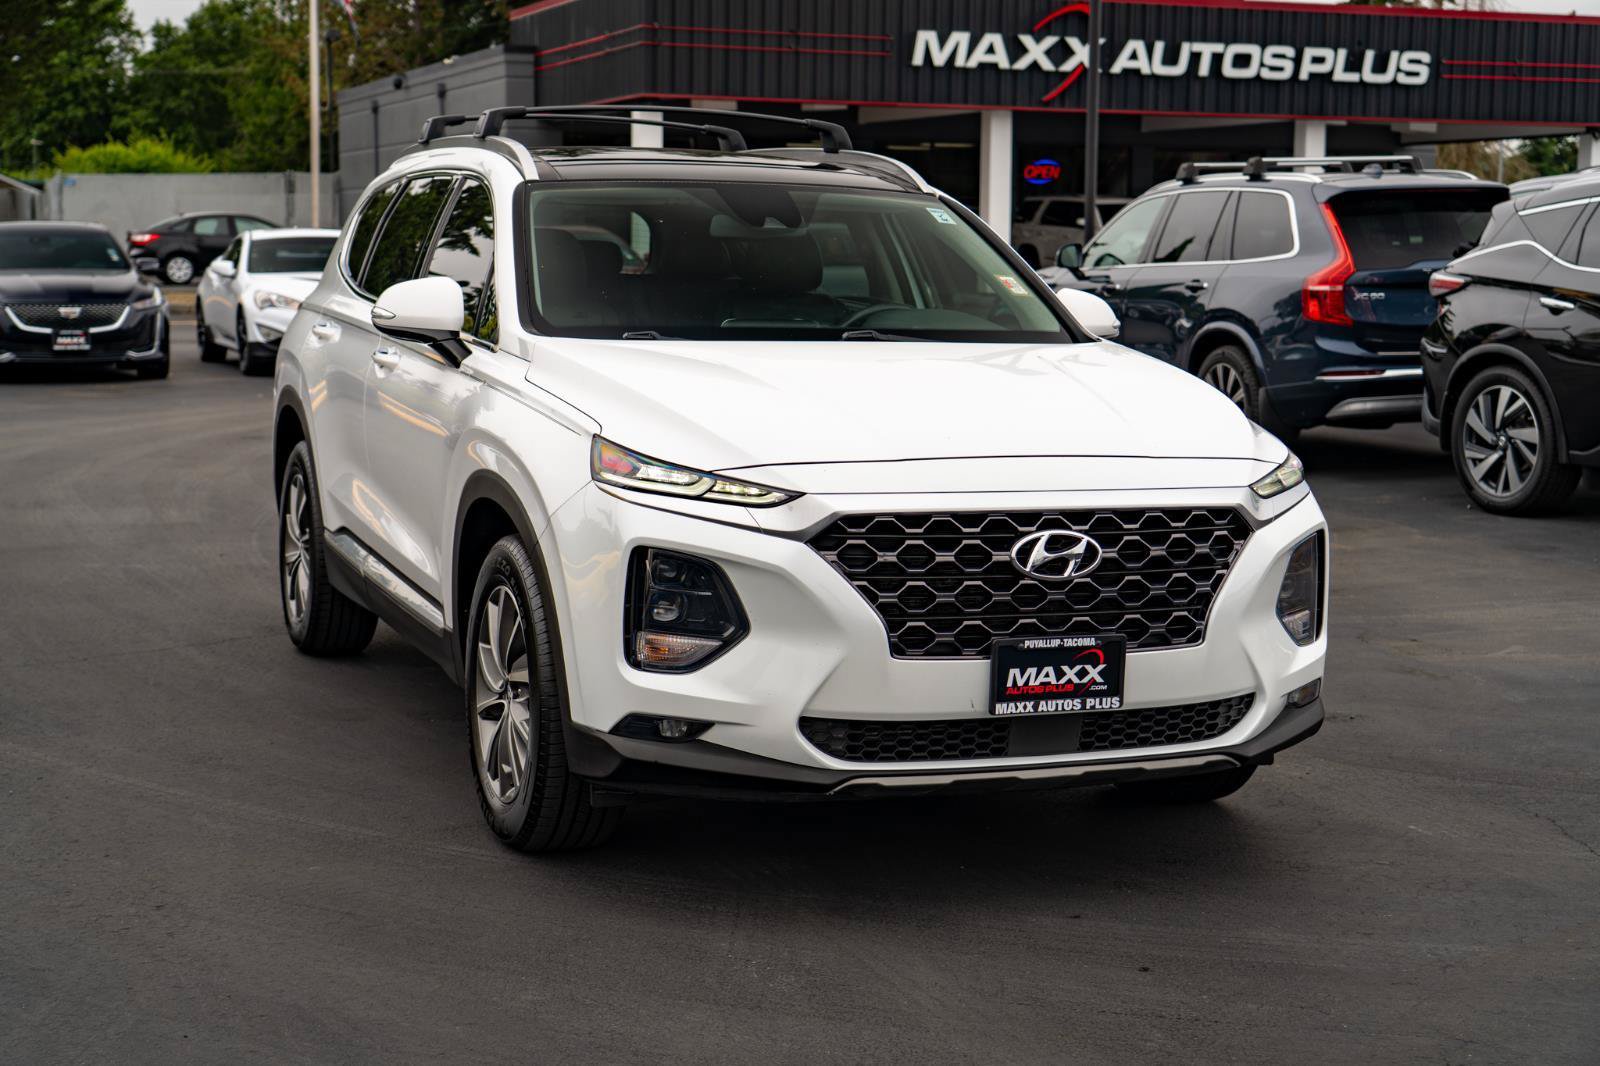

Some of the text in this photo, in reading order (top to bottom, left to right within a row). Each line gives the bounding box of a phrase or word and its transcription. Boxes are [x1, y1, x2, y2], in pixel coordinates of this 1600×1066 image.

[911, 29, 1432, 86] MAXX AUTOS PLUS
[1023, 164, 1061, 179] OPEN
[1006, 664, 1108, 688] MAXX
[1006, 685, 1045, 695] AUTOS
[1045, 683, 1075, 693] PLUS
[995, 697, 1120, 715] MAXX AUTOS PLUS
